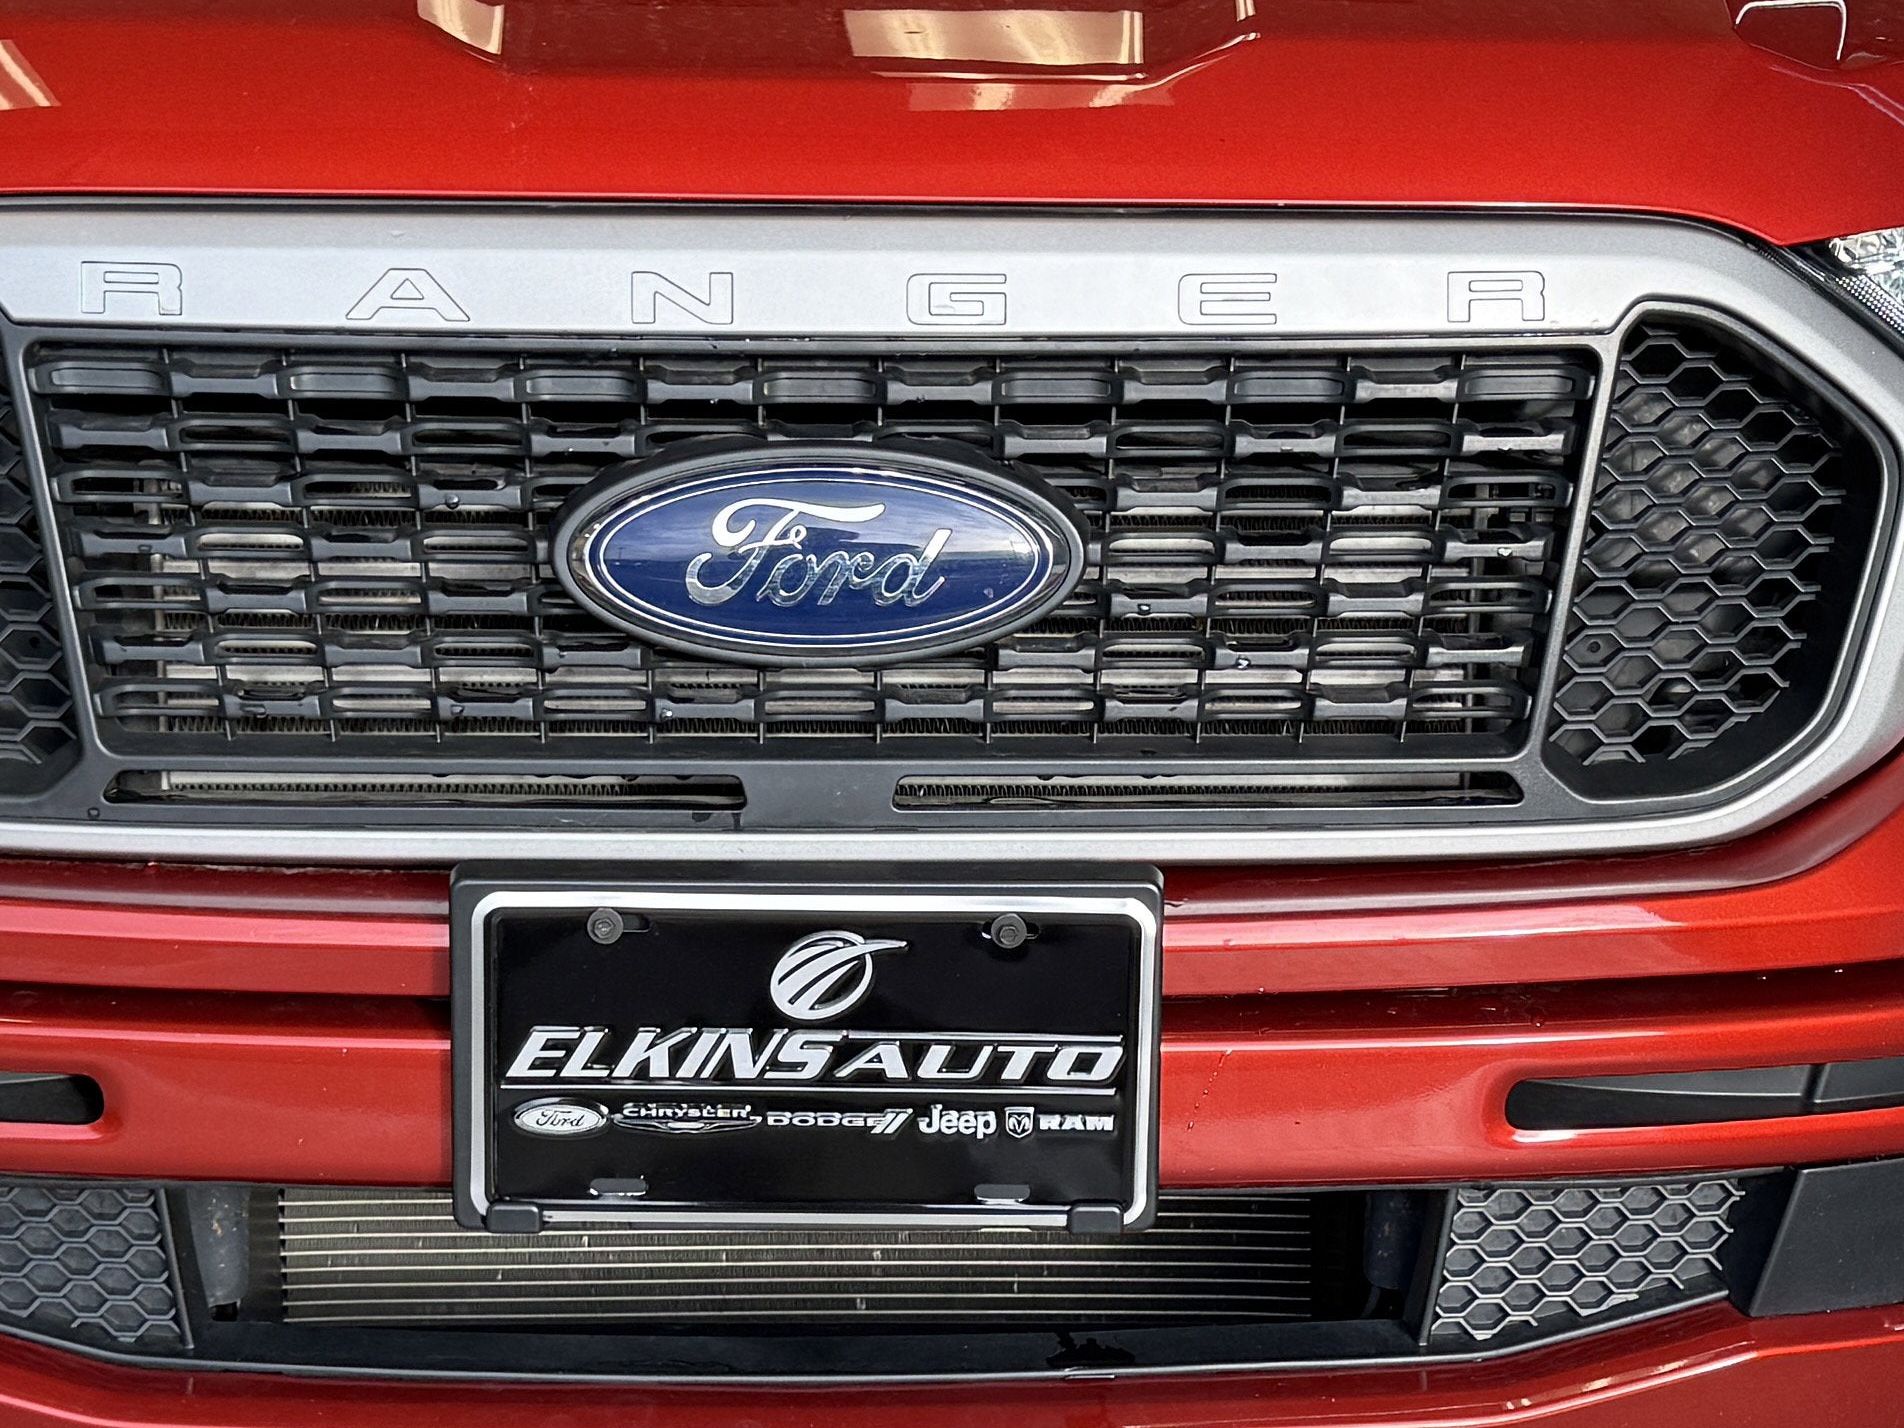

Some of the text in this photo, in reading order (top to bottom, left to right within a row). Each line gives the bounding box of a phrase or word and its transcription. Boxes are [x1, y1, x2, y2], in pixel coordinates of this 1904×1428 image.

[79, 260, 1546, 326] RANGER
[684, 497, 953, 609] Ford
[504, 1025, 1125, 1081] ELKINS AUTO
[535, 1101, 1116, 1139] Ford CHRYSLER DODGE Jeep RAM
